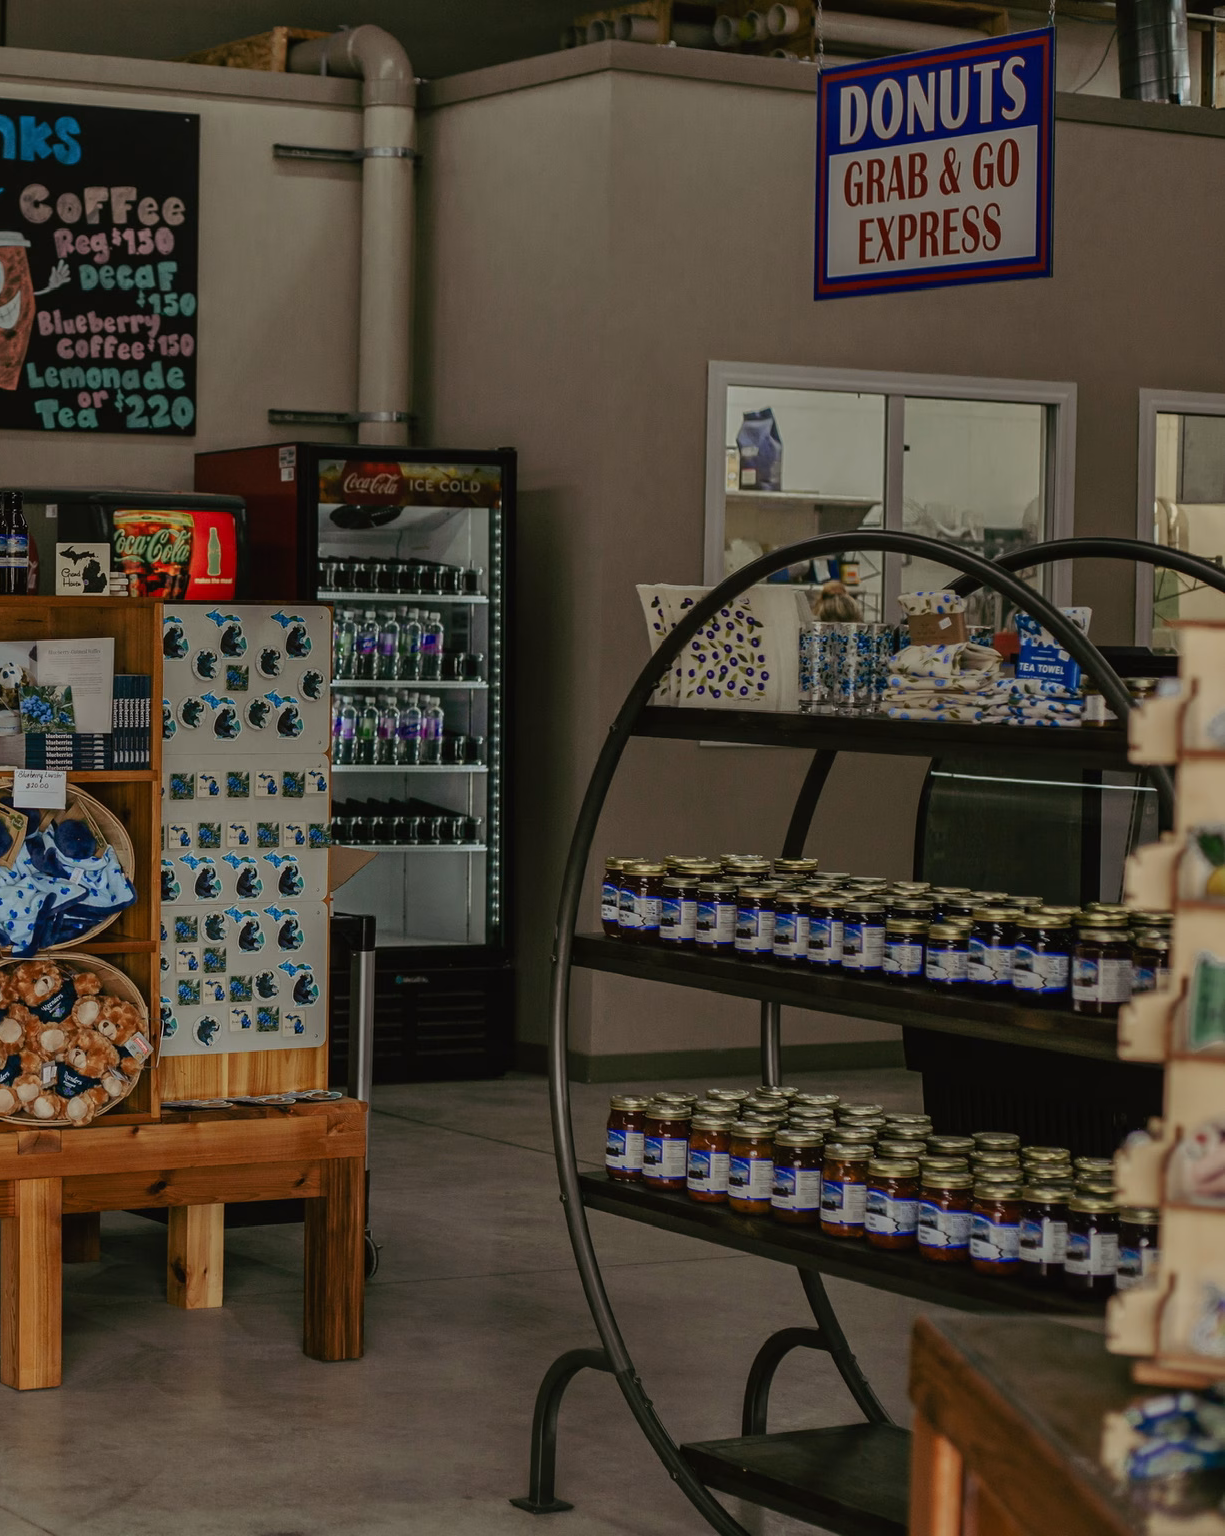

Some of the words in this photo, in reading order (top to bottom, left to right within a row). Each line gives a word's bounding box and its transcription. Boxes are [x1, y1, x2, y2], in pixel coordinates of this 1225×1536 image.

[839, 55, 1026, 145] DONUTS
[844, 152, 928, 207] GRAB
[939, 147, 961, 196] &
[972, 138, 1019, 191] GO
[858, 202, 1002, 265] EXPRESS
[37, 309, 161, 338] Blueberry
[26, 361, 186, 391] Lemonade
[34, 399, 99, 429] Tea
[77, 390, 109, 408] or
[409, 479, 435, 492] ICE
[439, 480, 481, 493] COLD
[1019, 662, 1036, 673] TEA
[1037, 663, 1065, 675] TOWEL
